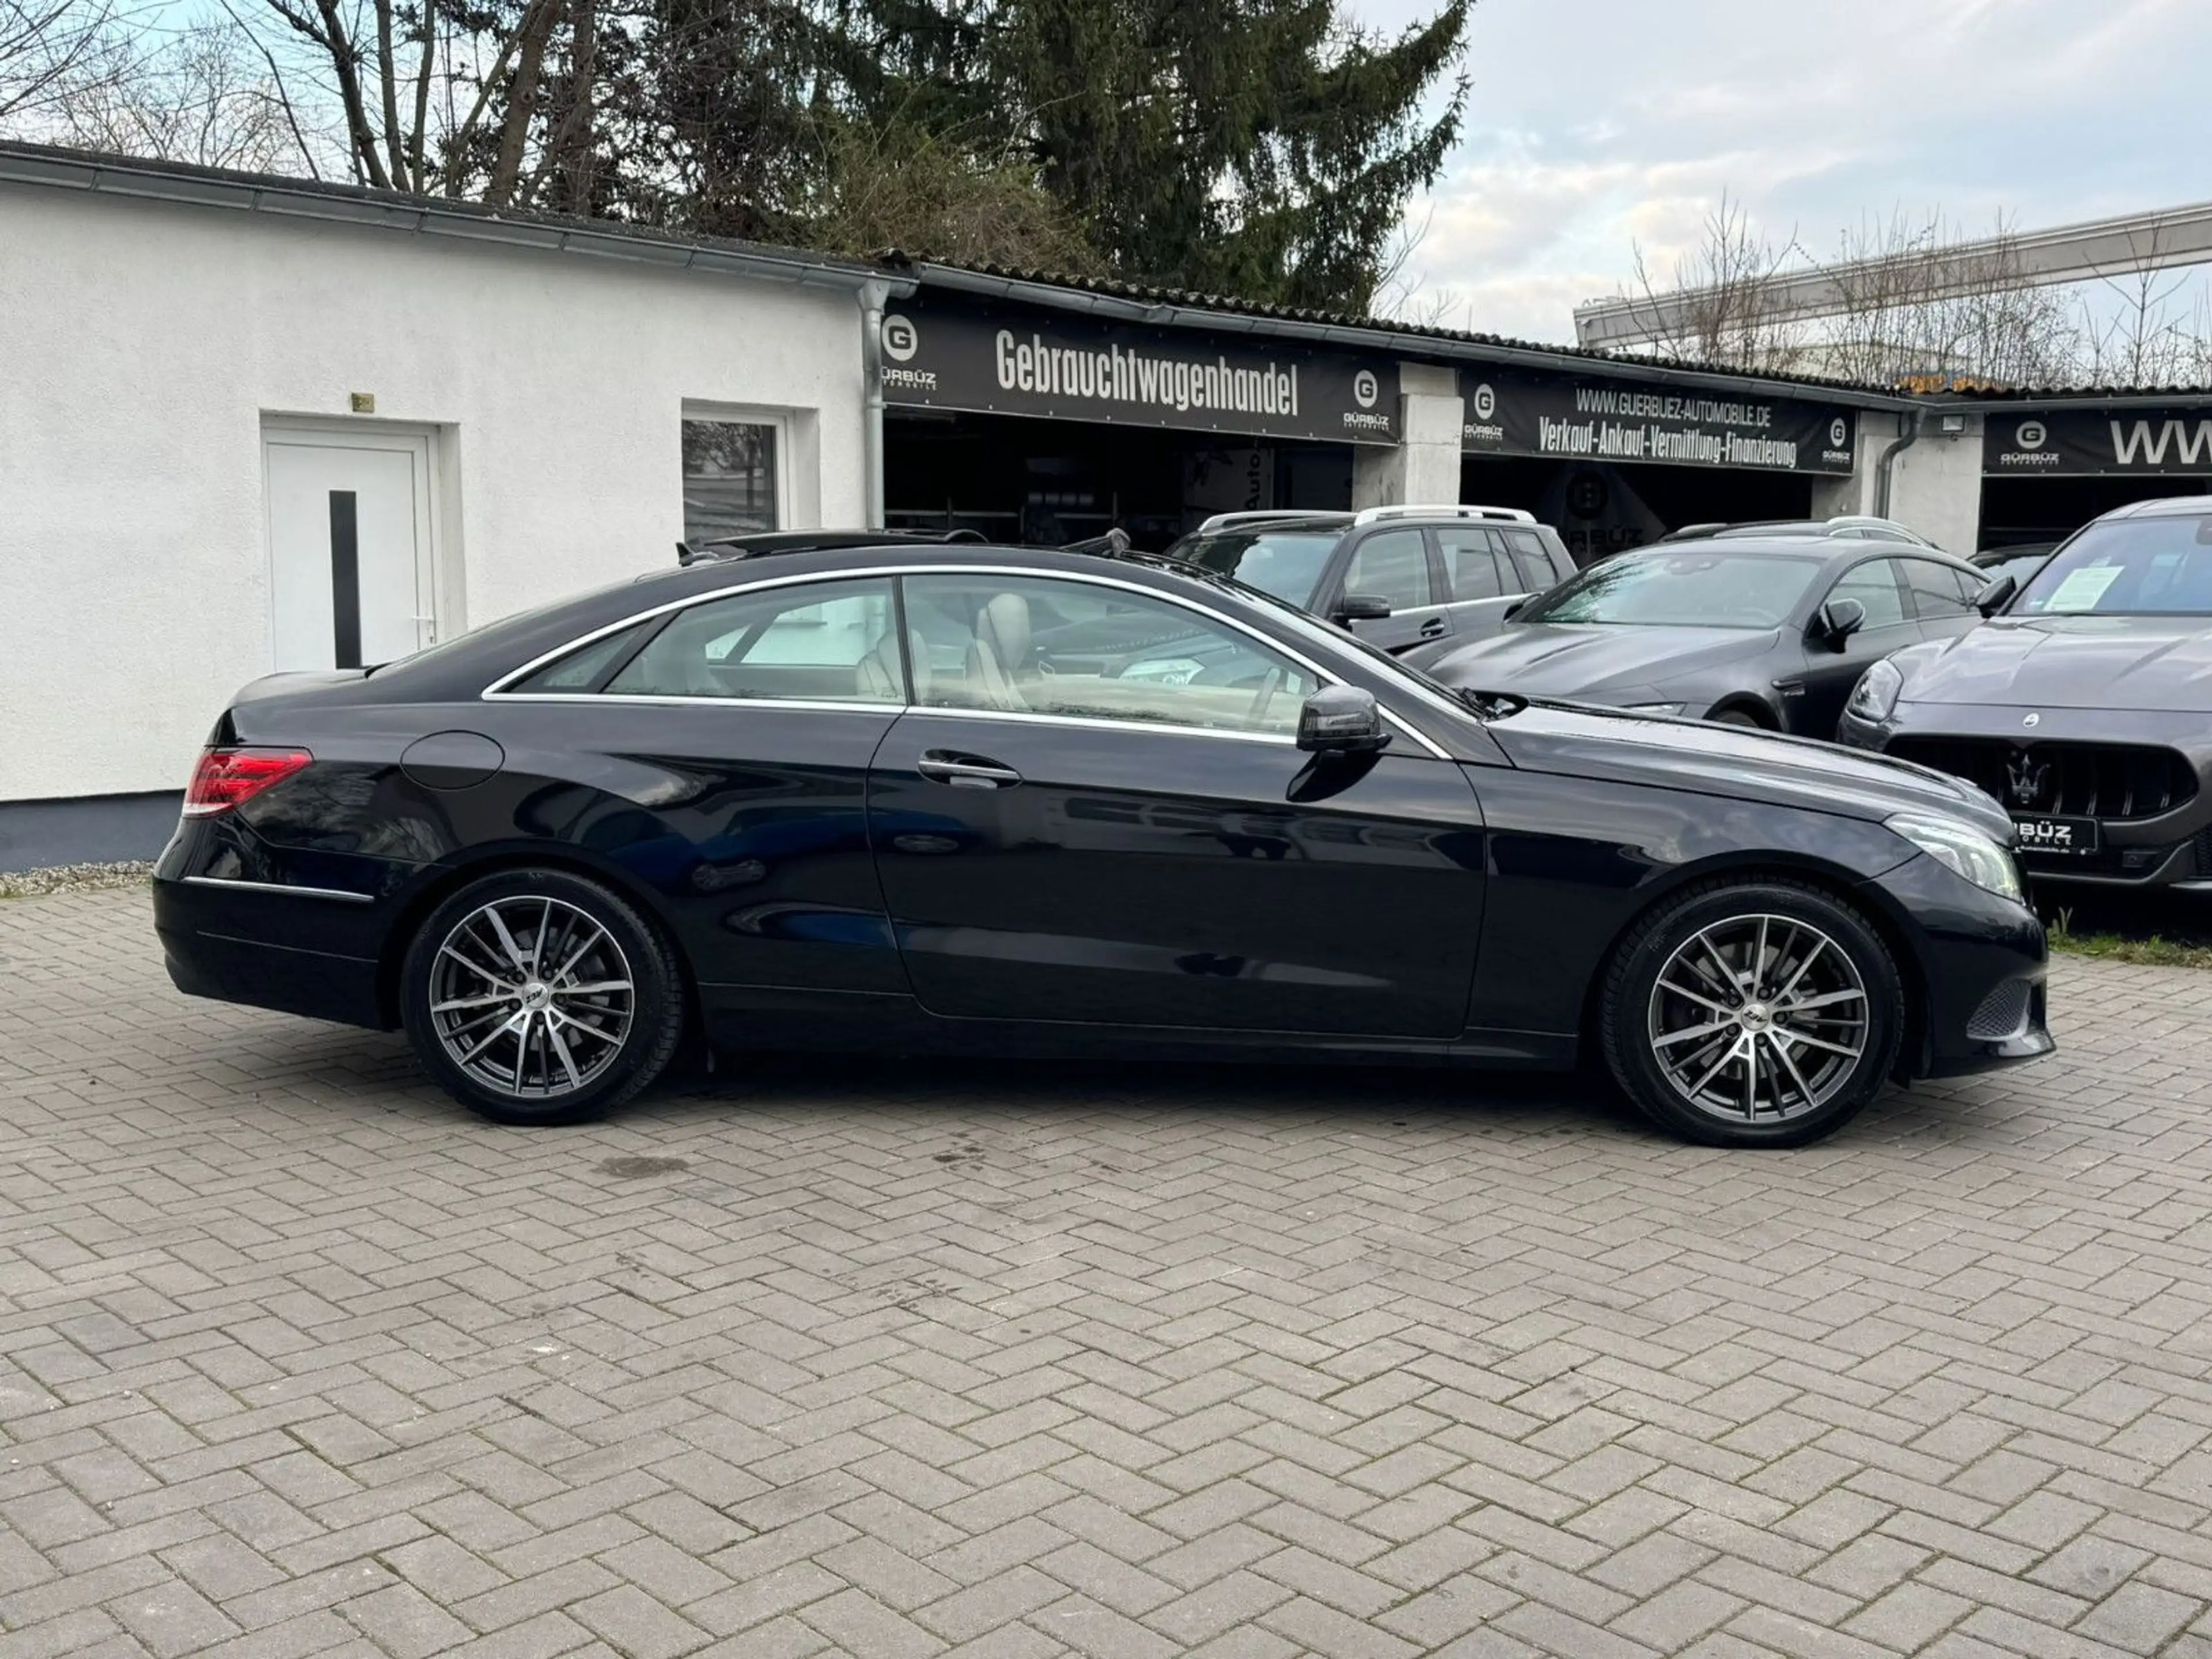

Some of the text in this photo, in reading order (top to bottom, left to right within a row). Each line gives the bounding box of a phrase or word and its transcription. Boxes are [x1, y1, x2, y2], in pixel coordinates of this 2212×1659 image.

[881, 366, 936, 384] ÜRBÜZ
[995, 329, 1298, 416] Gebrauchtwagenhandel
[1577, 388, 1771, 427] WWW.GUERBUEZ-AUTOMOBILE.DE
[1539, 416, 1797, 469] Verkauf-Ankauf-Vermittlung-Finanzierung
[1568, 524, 1645, 545] RBÜZ
[2013, 821, 2071, 839] BÜZ
